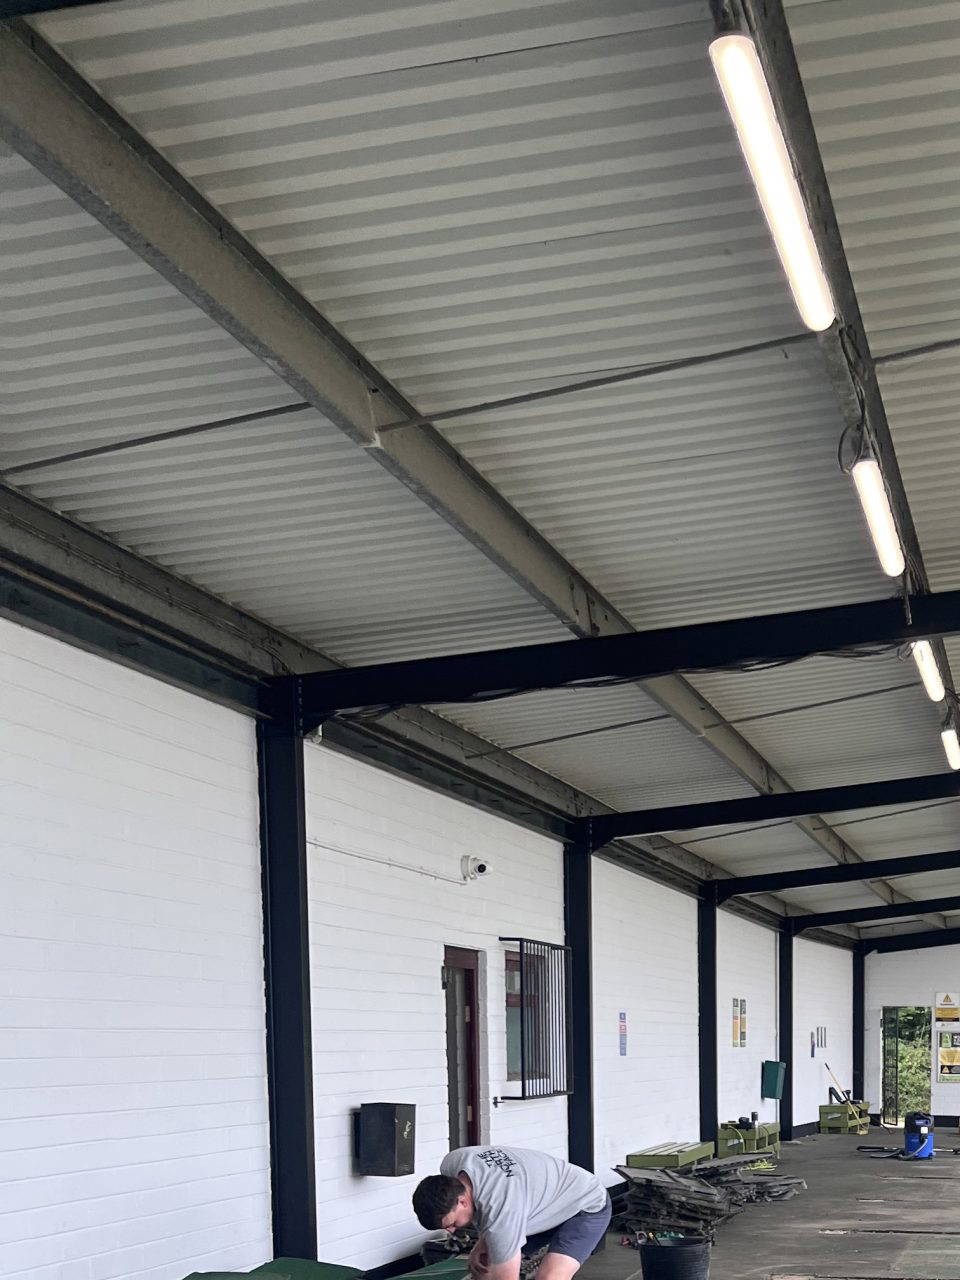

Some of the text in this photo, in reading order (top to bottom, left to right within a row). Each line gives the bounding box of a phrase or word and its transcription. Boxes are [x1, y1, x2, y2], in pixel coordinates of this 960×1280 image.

[477, 1153, 492, 1168] THE
[483, 1150, 514, 1177] NORTH
[496, 1148, 517, 1167] FACE
